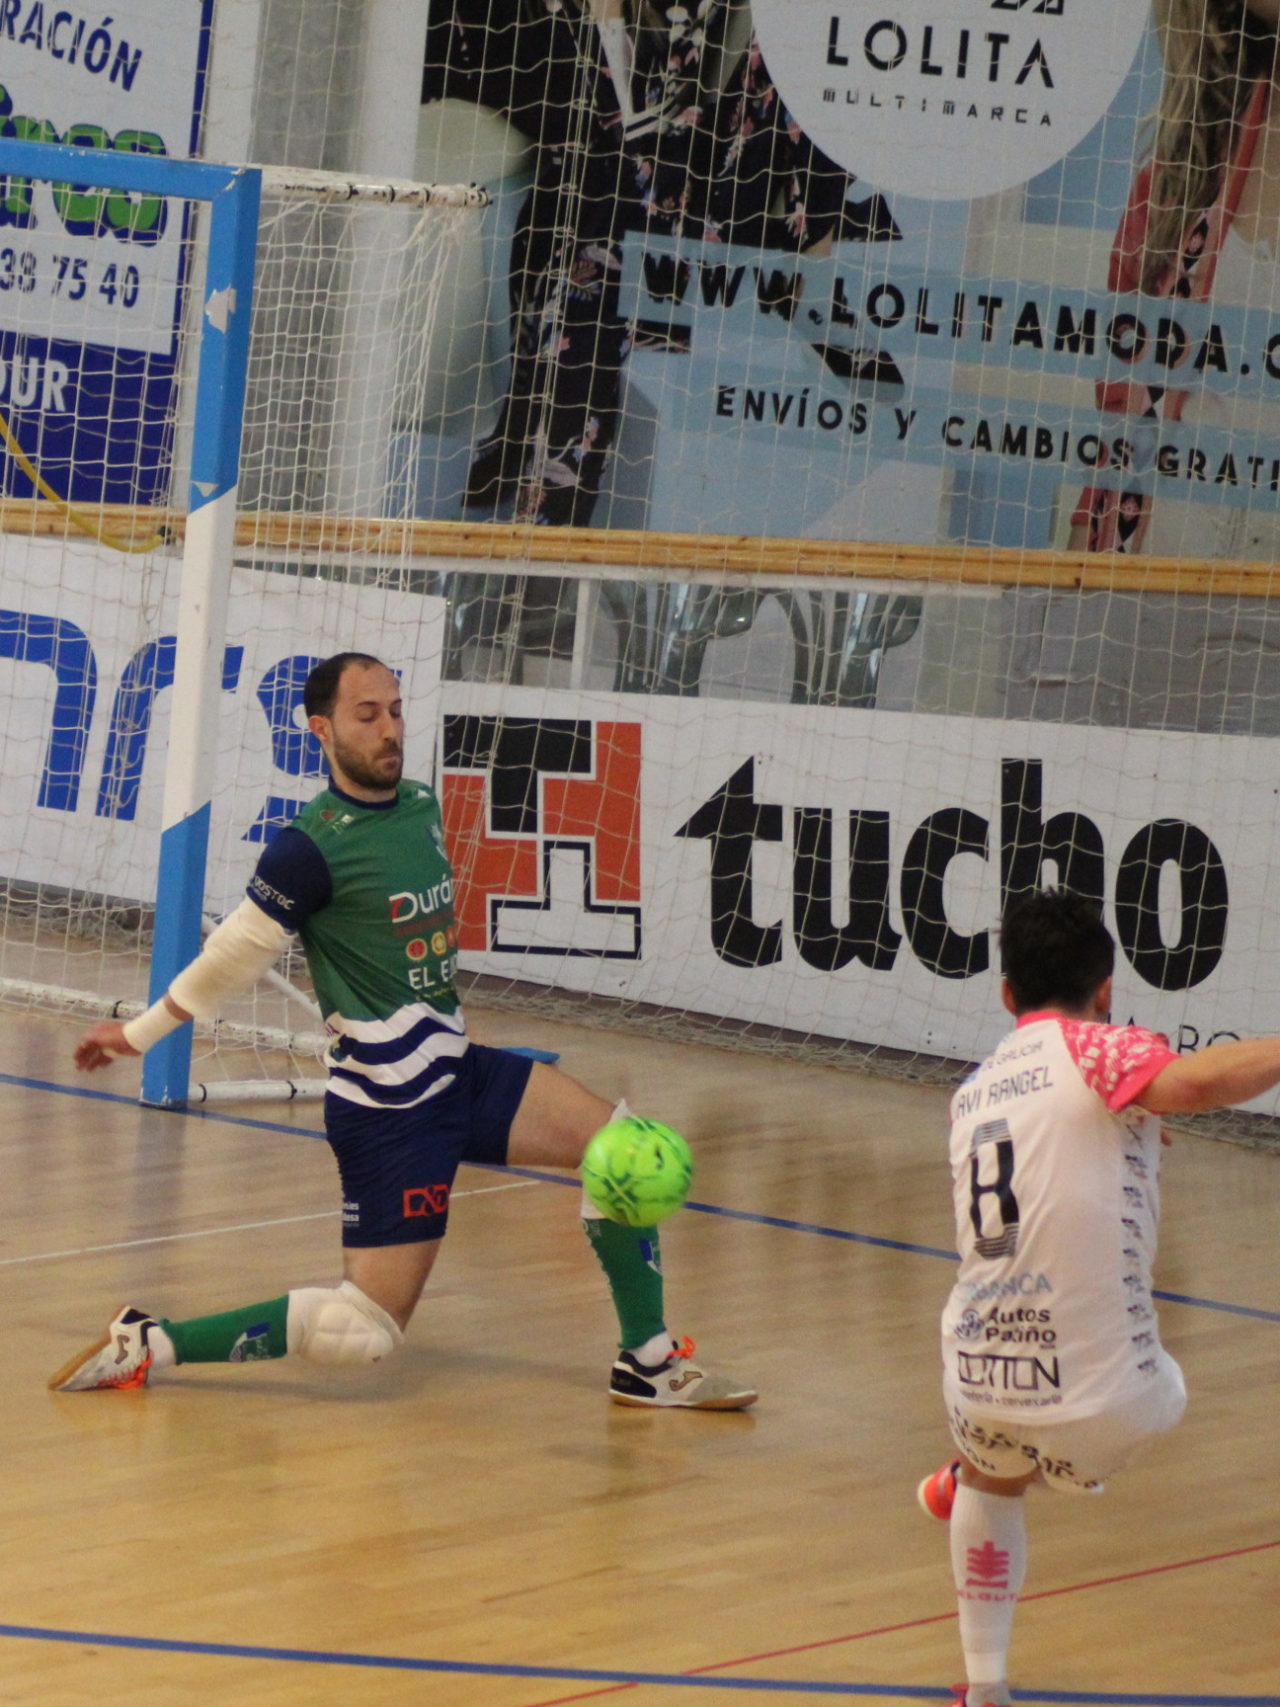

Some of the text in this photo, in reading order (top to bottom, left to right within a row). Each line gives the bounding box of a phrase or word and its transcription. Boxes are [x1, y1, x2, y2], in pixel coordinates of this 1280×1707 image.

[826, 16, 1054, 88] LOLITA
[822, 87, 1051, 126] MULTIMARCA
[51, 254, 88, 301] 75
[98, 263, 140, 310] 40
[715, 386, 867, 434] ENVÍOS
[896, 408, 916, 440] Y
[942, 415, 1132, 470] CAMBIOS
[388, 873, 454, 923] Durá
[673, 755, 1230, 992] tucho
[408, 966, 436, 990] EL
[987, 1066, 1054, 1107] RANGEL
[969, 1118, 1020, 1260] 8
[986, 1306, 1051, 1325] Autos
[986, 1327, 1057, 1343] Patiño
